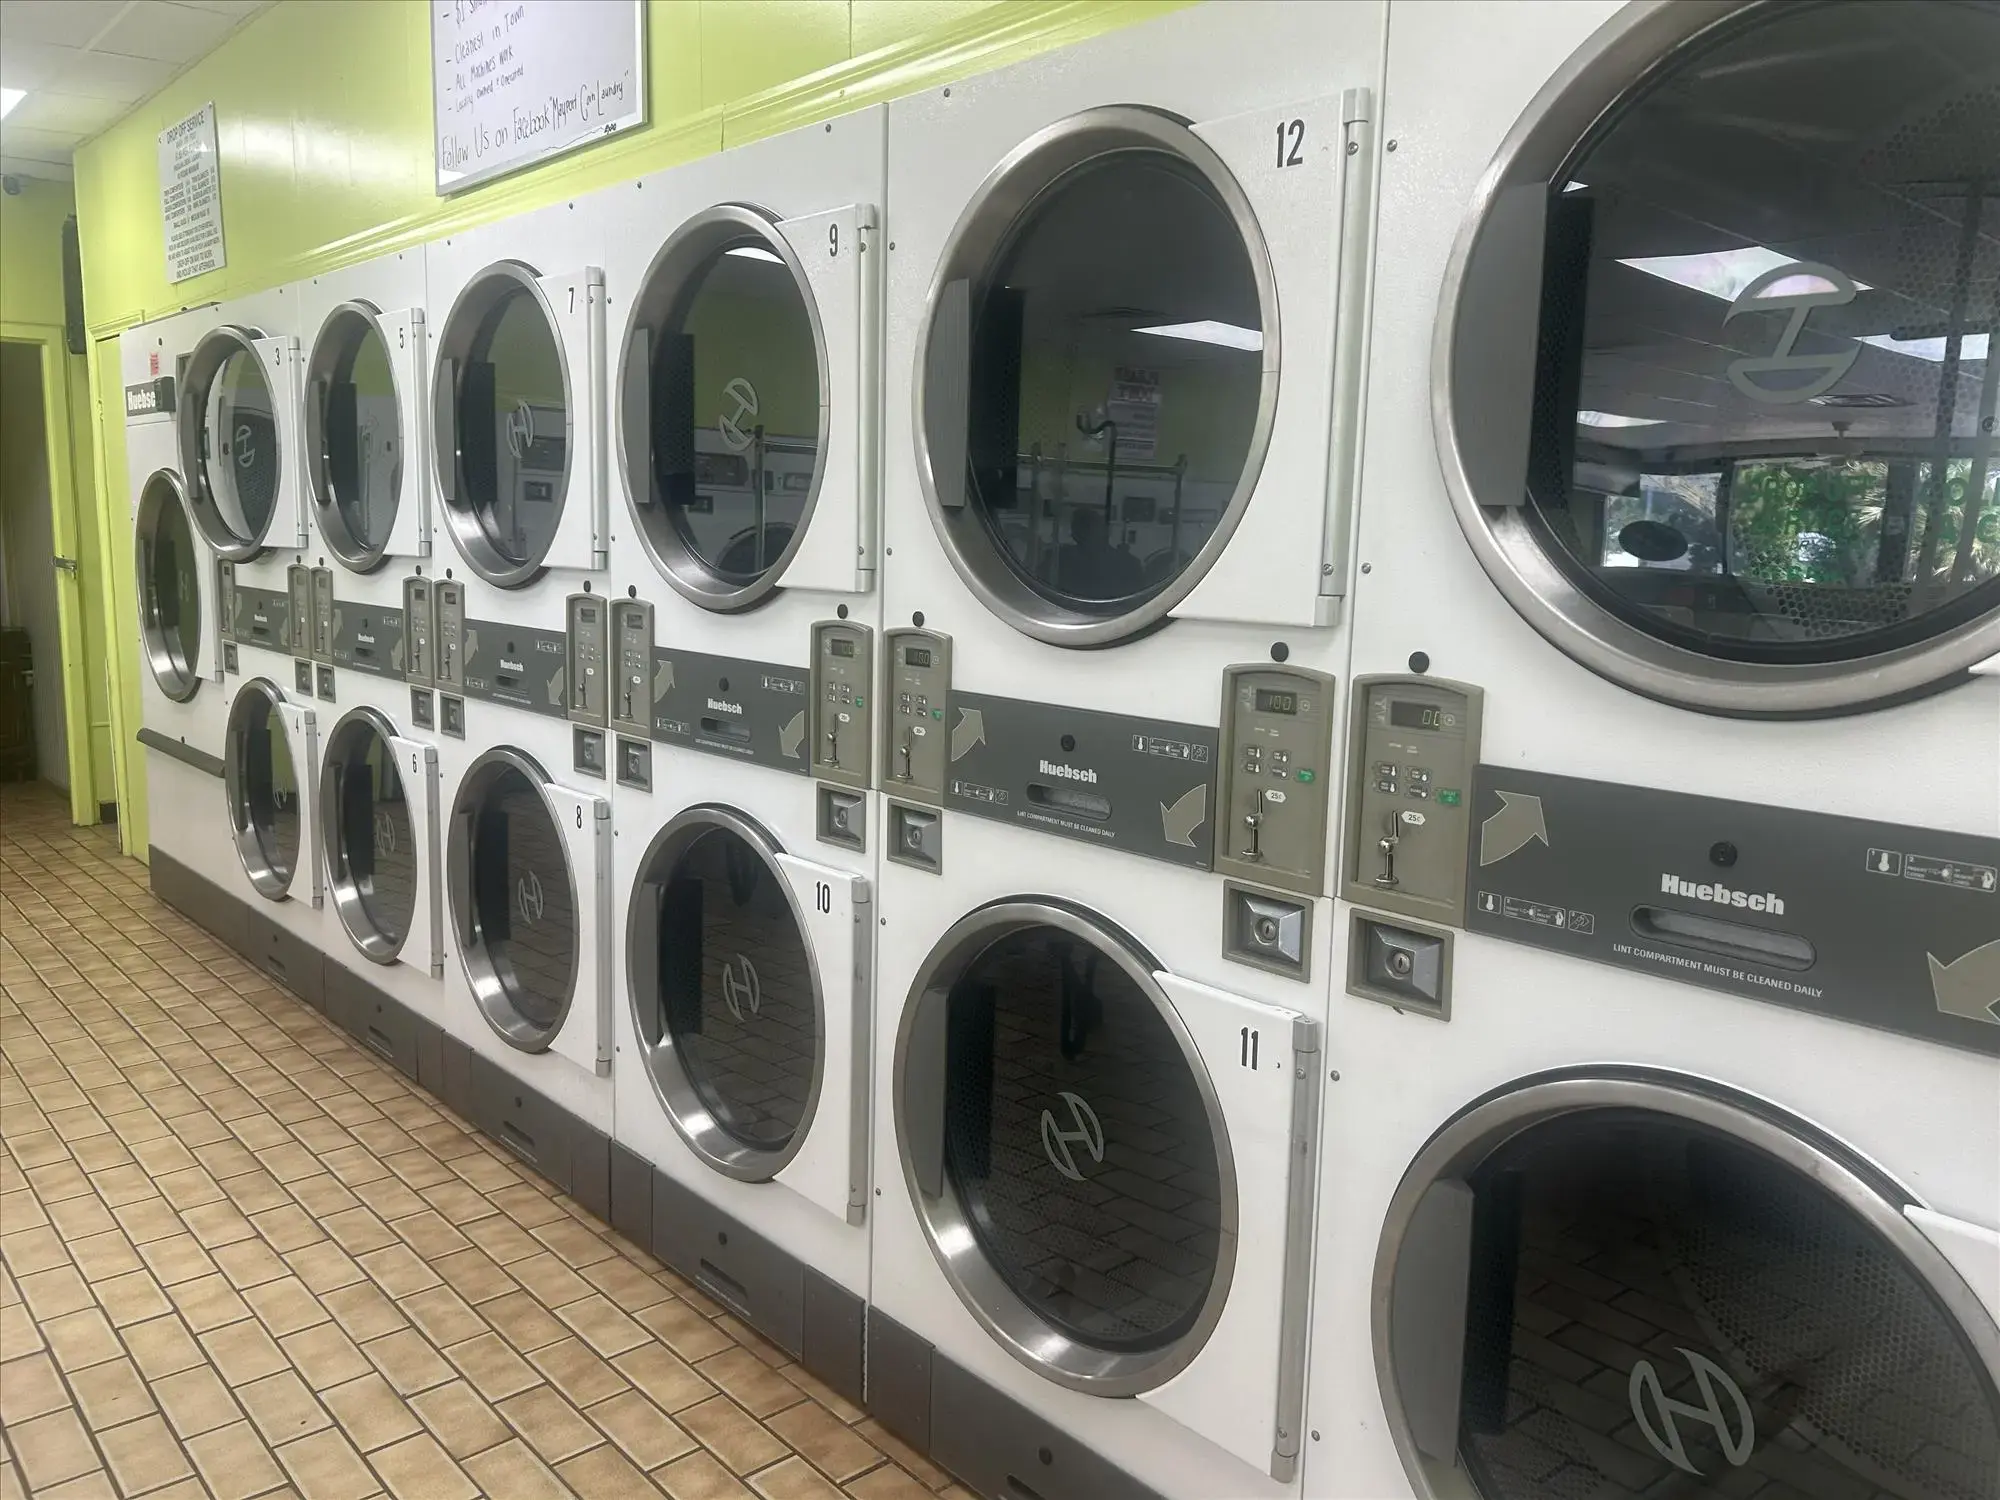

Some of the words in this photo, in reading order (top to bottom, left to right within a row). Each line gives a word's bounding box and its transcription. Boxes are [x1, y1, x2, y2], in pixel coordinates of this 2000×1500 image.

[442, 135, 469, 170] Follow
[475, 122, 490, 157] Us
[495, 127, 508, 148] on
[513, 104, 550, 145] Facebook
[1277, 119, 1305, 168] 12
[830, 223, 838, 257] 9
[569, 287, 574, 313] 7
[400, 328, 404, 348] 5
[276, 347, 280, 365] 3
[127, 388, 156, 411] Huebsc
[707, 697, 743, 714] Huebsch
[412, 753, 417, 773] 6
[1039, 759, 1097, 784] Huebsch
[576, 804, 582, 829] 8
[816, 881, 830, 914] 10
[1660, 873, 1785, 915] Huebsch
[1613, 943, 1631, 954] LINT
[1633, 947, 1702, 970] COMPARTMENT
[1704, 964, 1730, 977] MUST
[1732, 970, 1745, 980] BE
[1747, 973, 1792, 991] CLEANED
[1793, 983, 1823, 998] DAILY
[1241, 1027, 1259, 1071] 11
